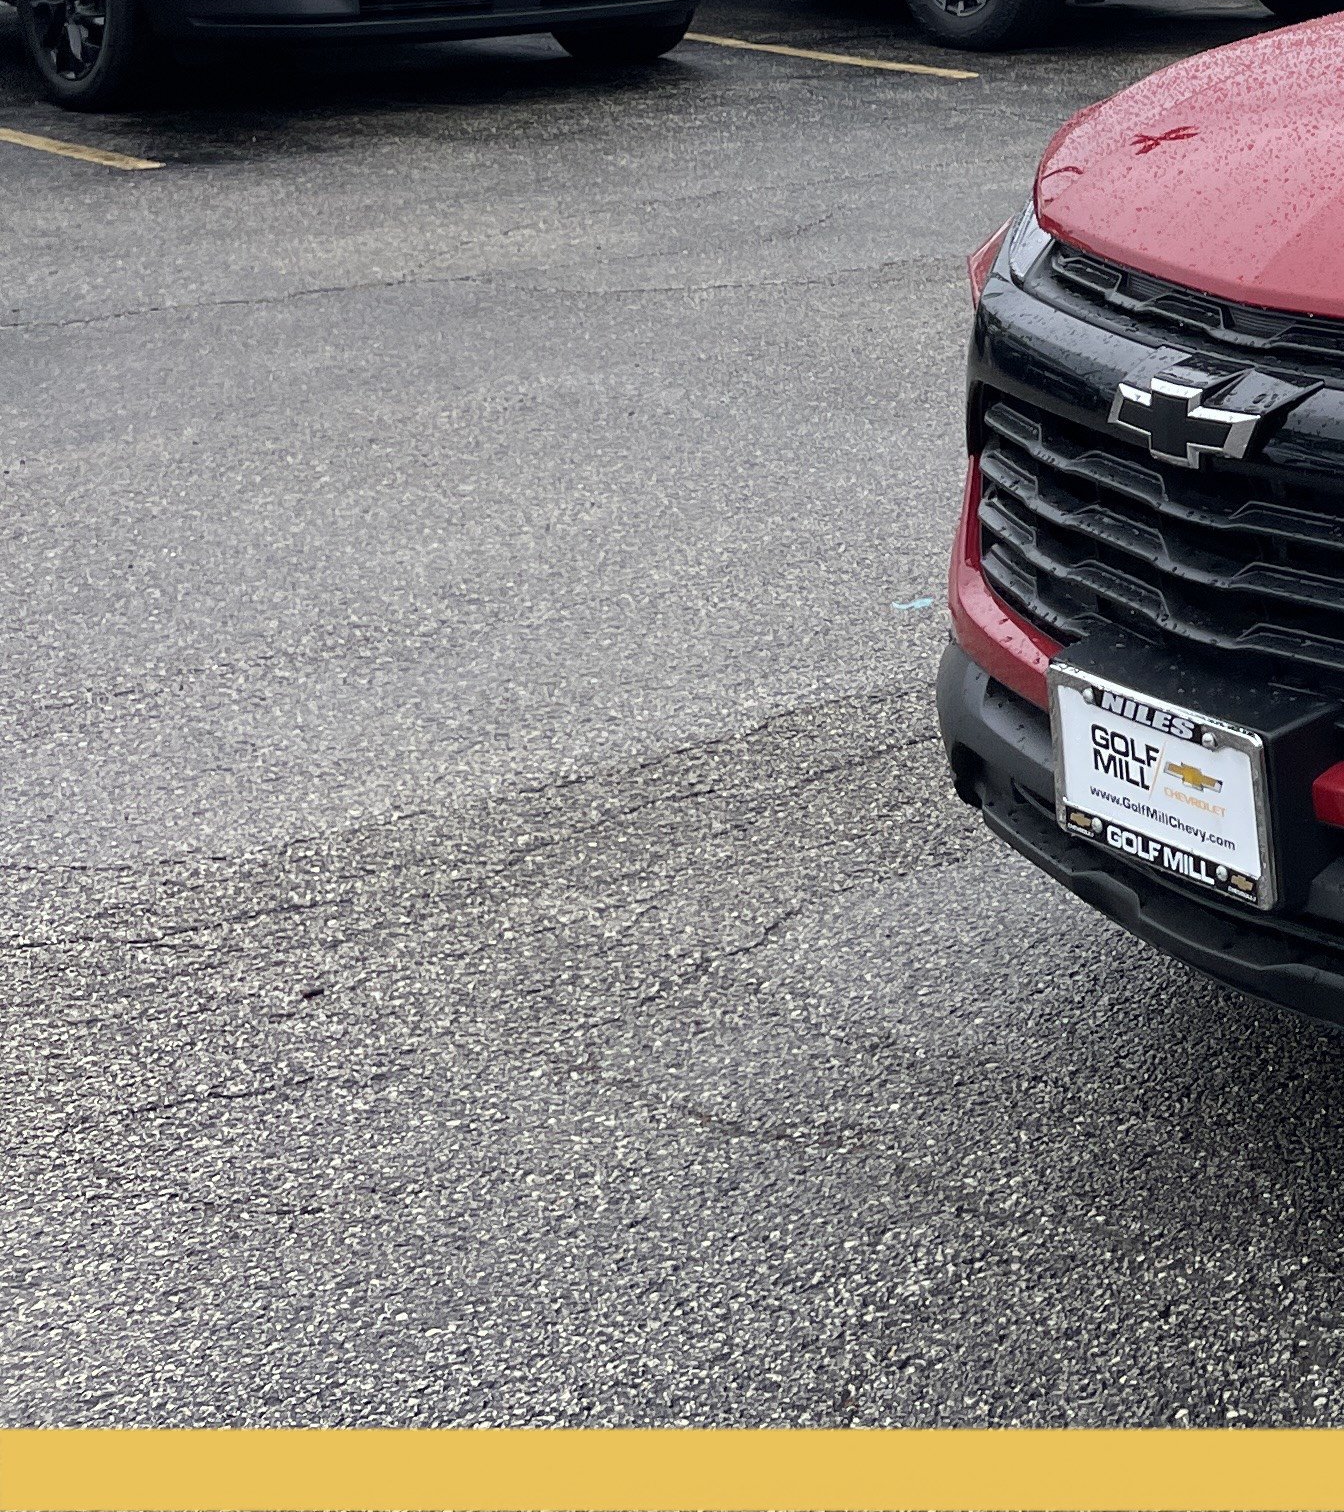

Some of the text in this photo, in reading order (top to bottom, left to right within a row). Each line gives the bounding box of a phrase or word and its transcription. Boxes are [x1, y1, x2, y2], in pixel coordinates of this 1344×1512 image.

[1101, 691, 1195, 740] NILES
[1091, 723, 1160, 767] GOLF
[1093, 747, 1150, 791] MILL
[1090, 785, 1236, 851] www.GolfMillChevy.com
[1164, 787, 1226, 818] CHEVROLET
[1106, 824, 1215, 886] GOLF MILL
